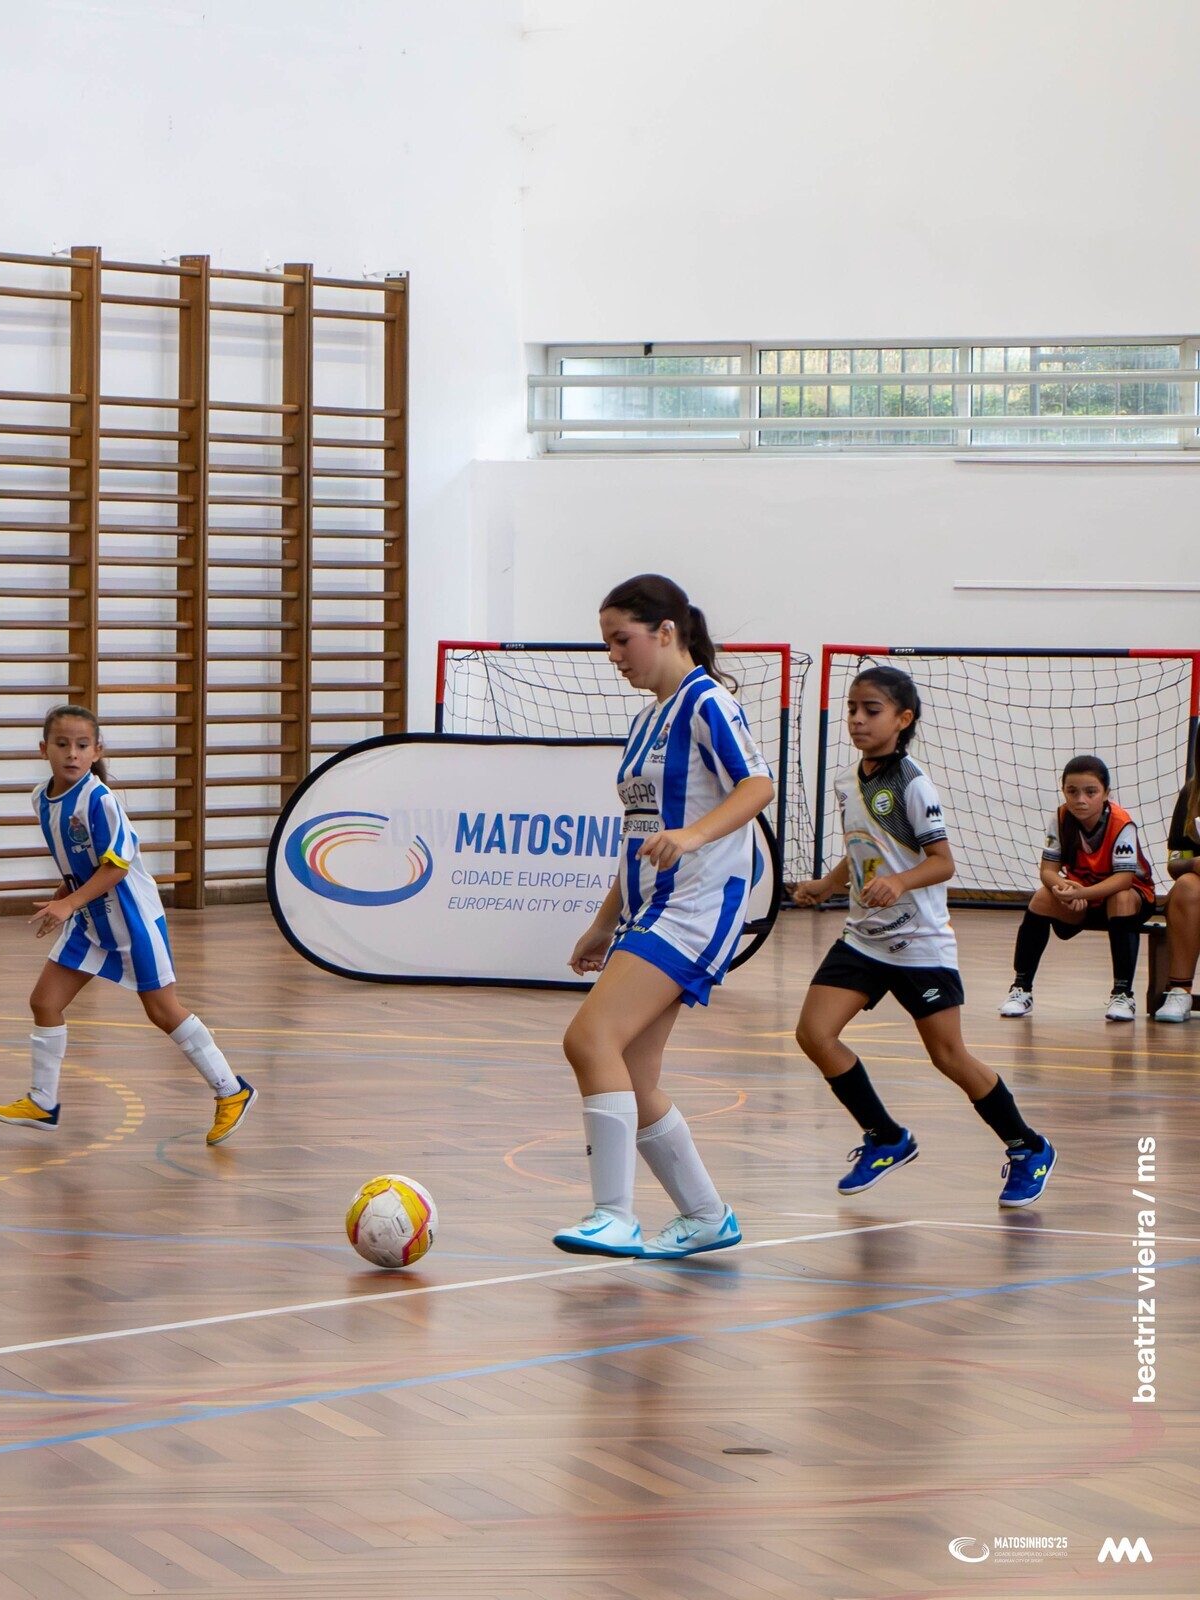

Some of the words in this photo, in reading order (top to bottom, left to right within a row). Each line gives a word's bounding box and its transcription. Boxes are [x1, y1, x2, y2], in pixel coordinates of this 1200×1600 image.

[451, 869, 514, 887] CIDADE
[517, 871, 603, 889] EUROPEIA
[447, 896, 524, 912] EUROPEAN
[527, 898, 560, 912] CITY
[562, 899, 583, 913] OF
